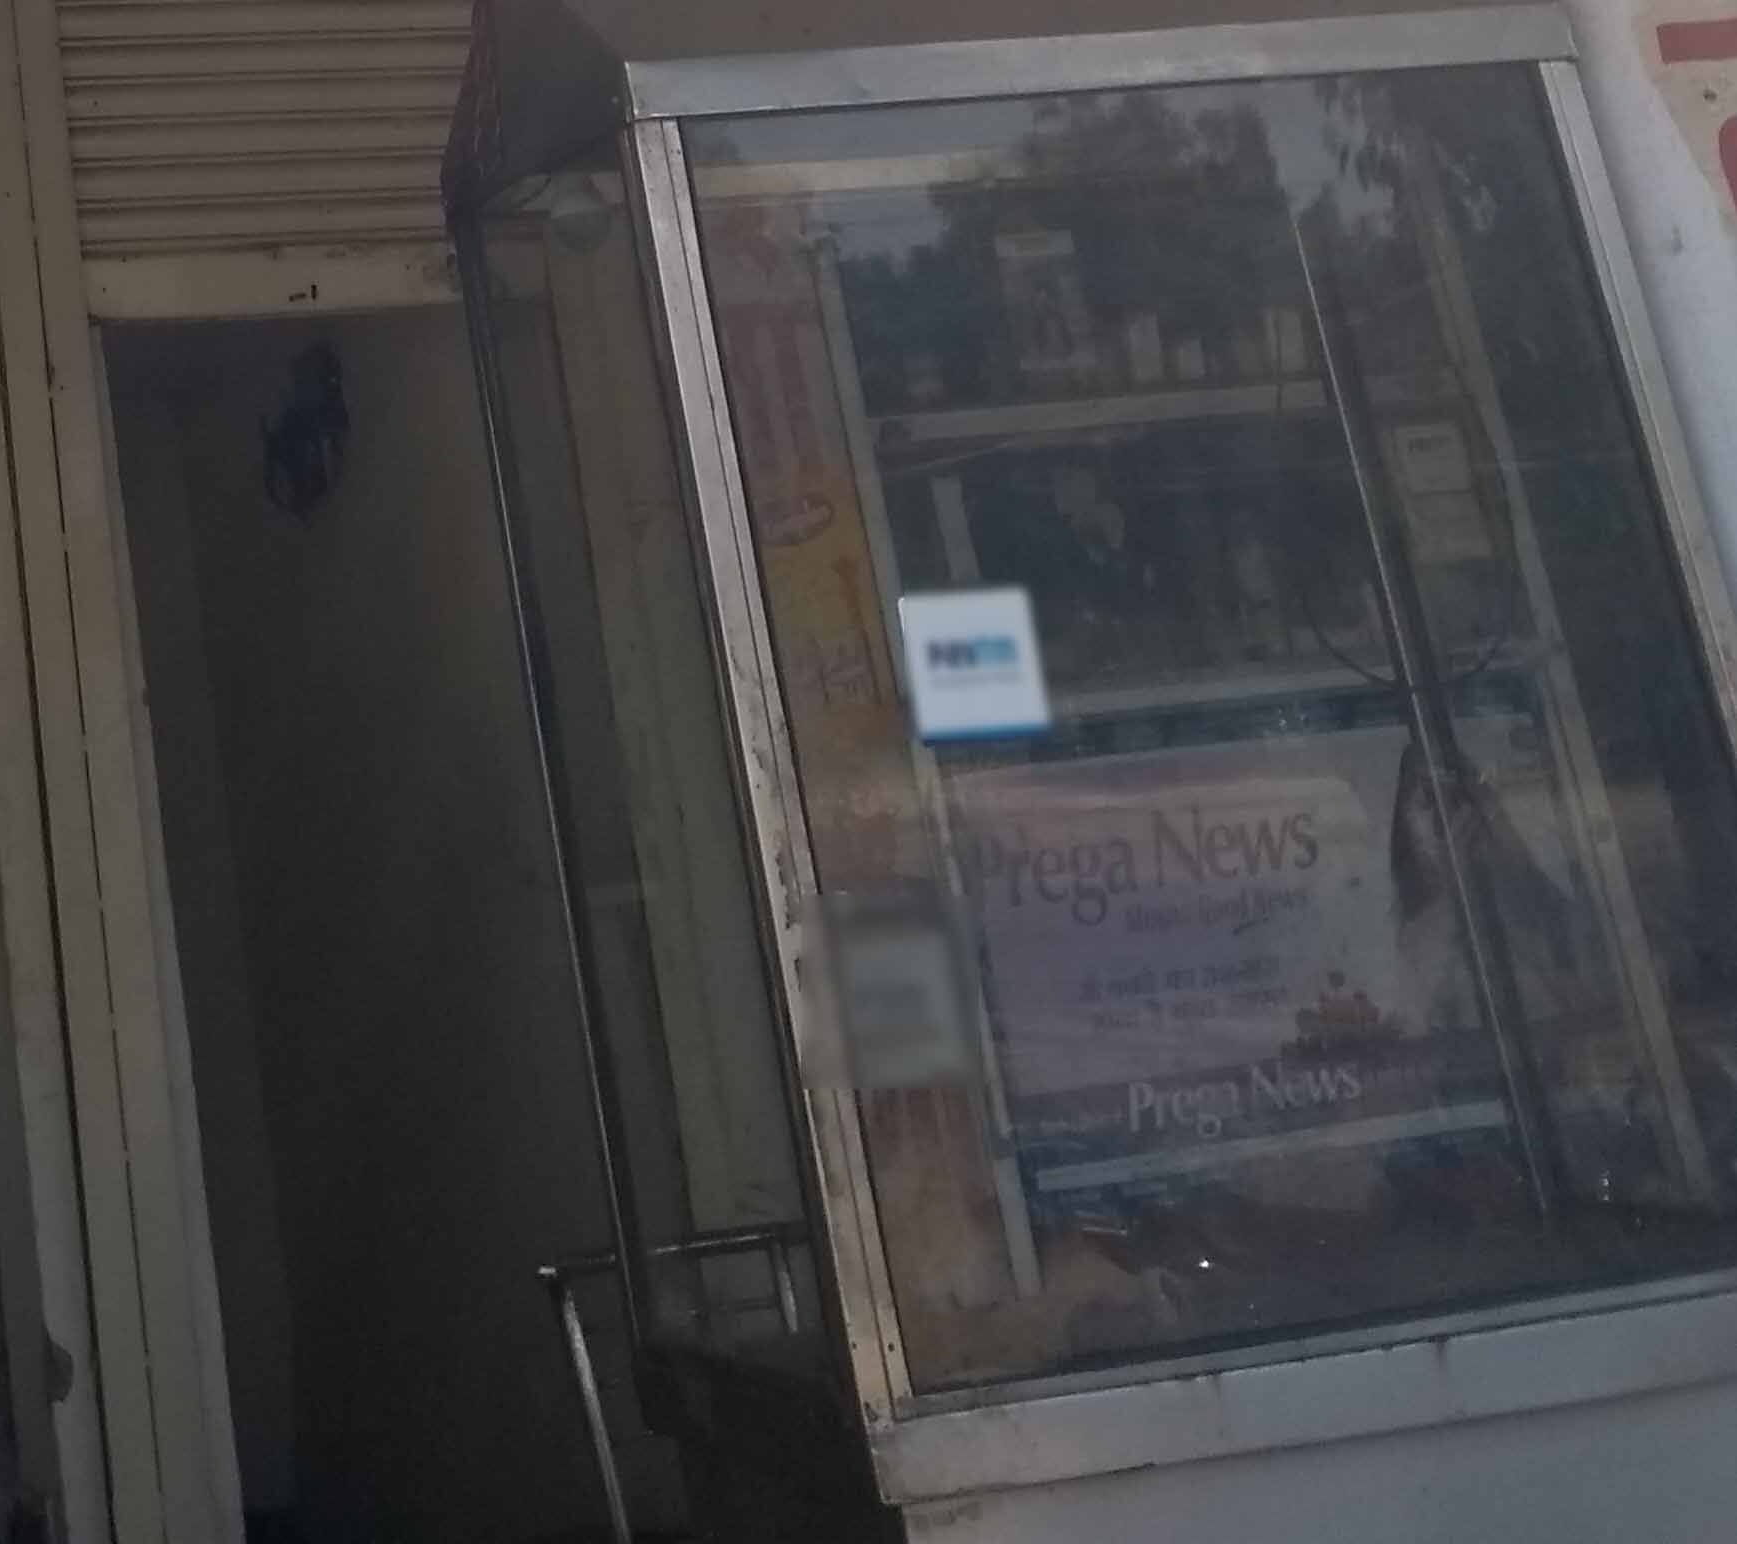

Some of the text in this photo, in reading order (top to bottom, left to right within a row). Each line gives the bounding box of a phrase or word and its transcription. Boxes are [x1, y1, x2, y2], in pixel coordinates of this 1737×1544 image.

[1151, 805, 1320, 887] News
[1126, 1058, 1363, 1139] Prega News
